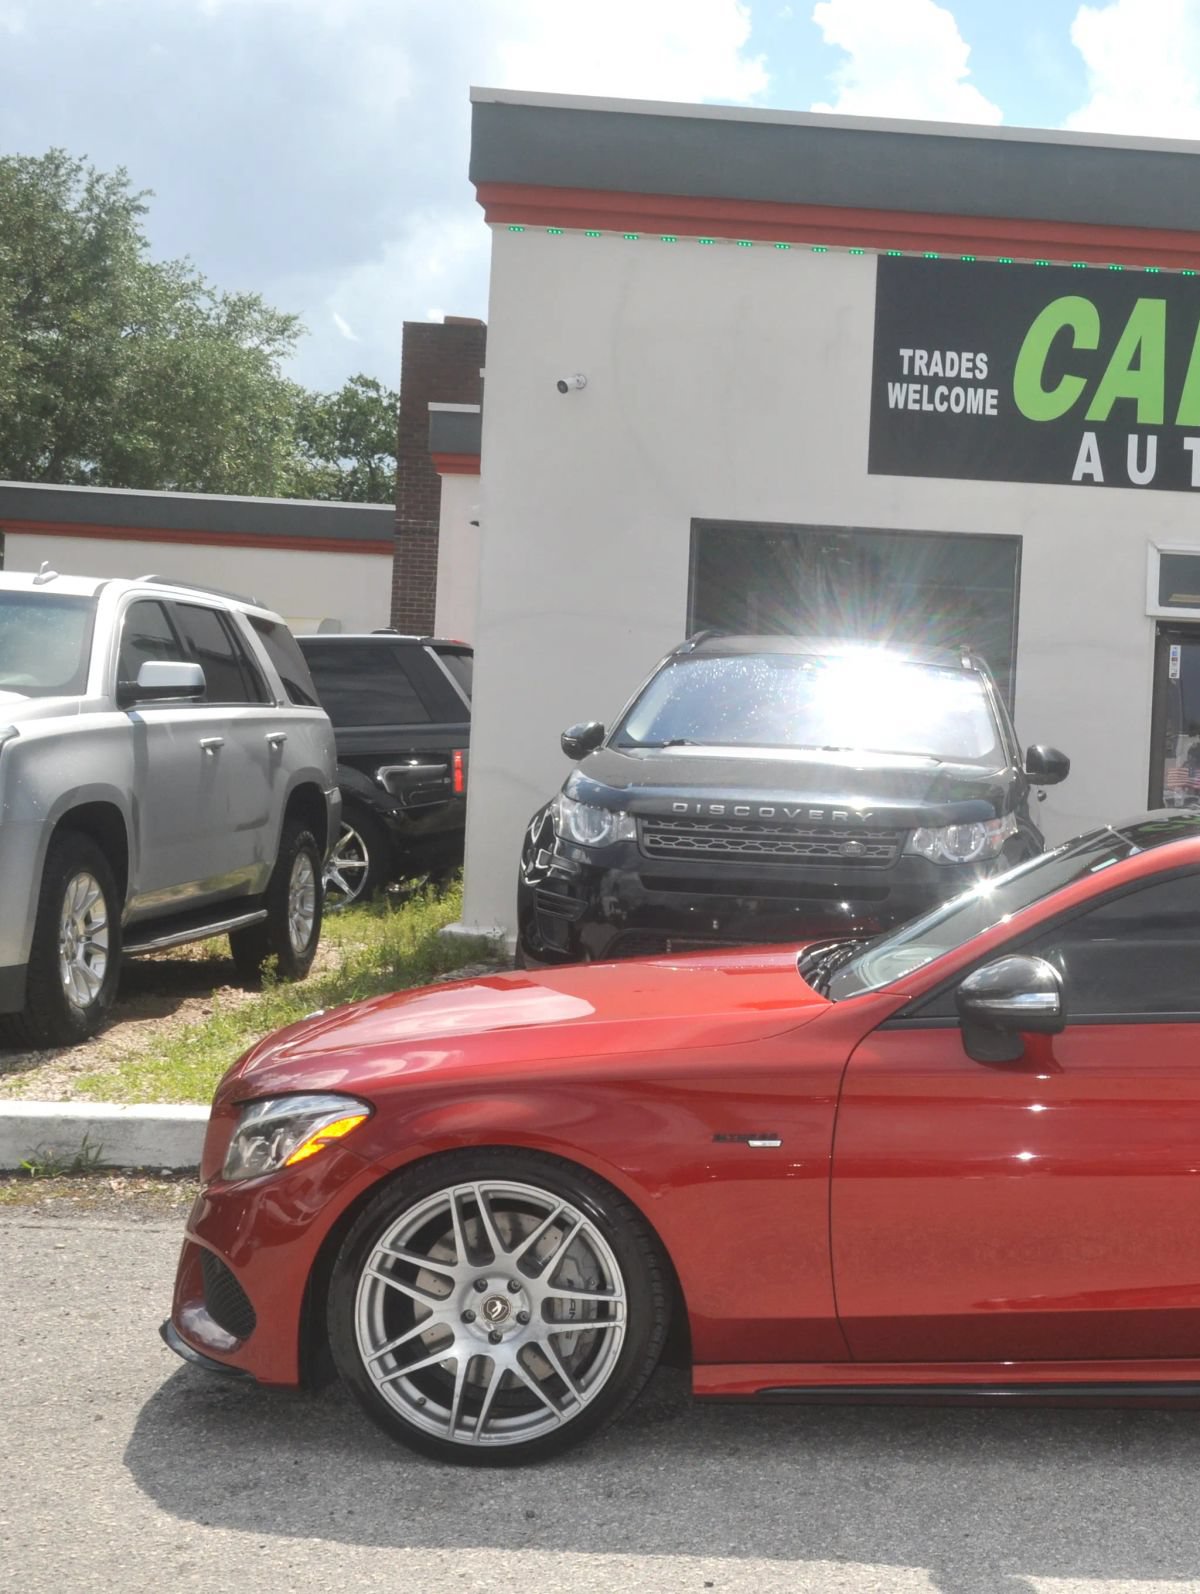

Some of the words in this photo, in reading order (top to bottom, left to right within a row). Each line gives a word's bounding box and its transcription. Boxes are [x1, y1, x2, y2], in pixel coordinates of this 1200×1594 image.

[899, 348, 989, 380] TRADES
[887, 381, 999, 417] WELCOME
[672, 802, 874, 822] DISCOVERY
